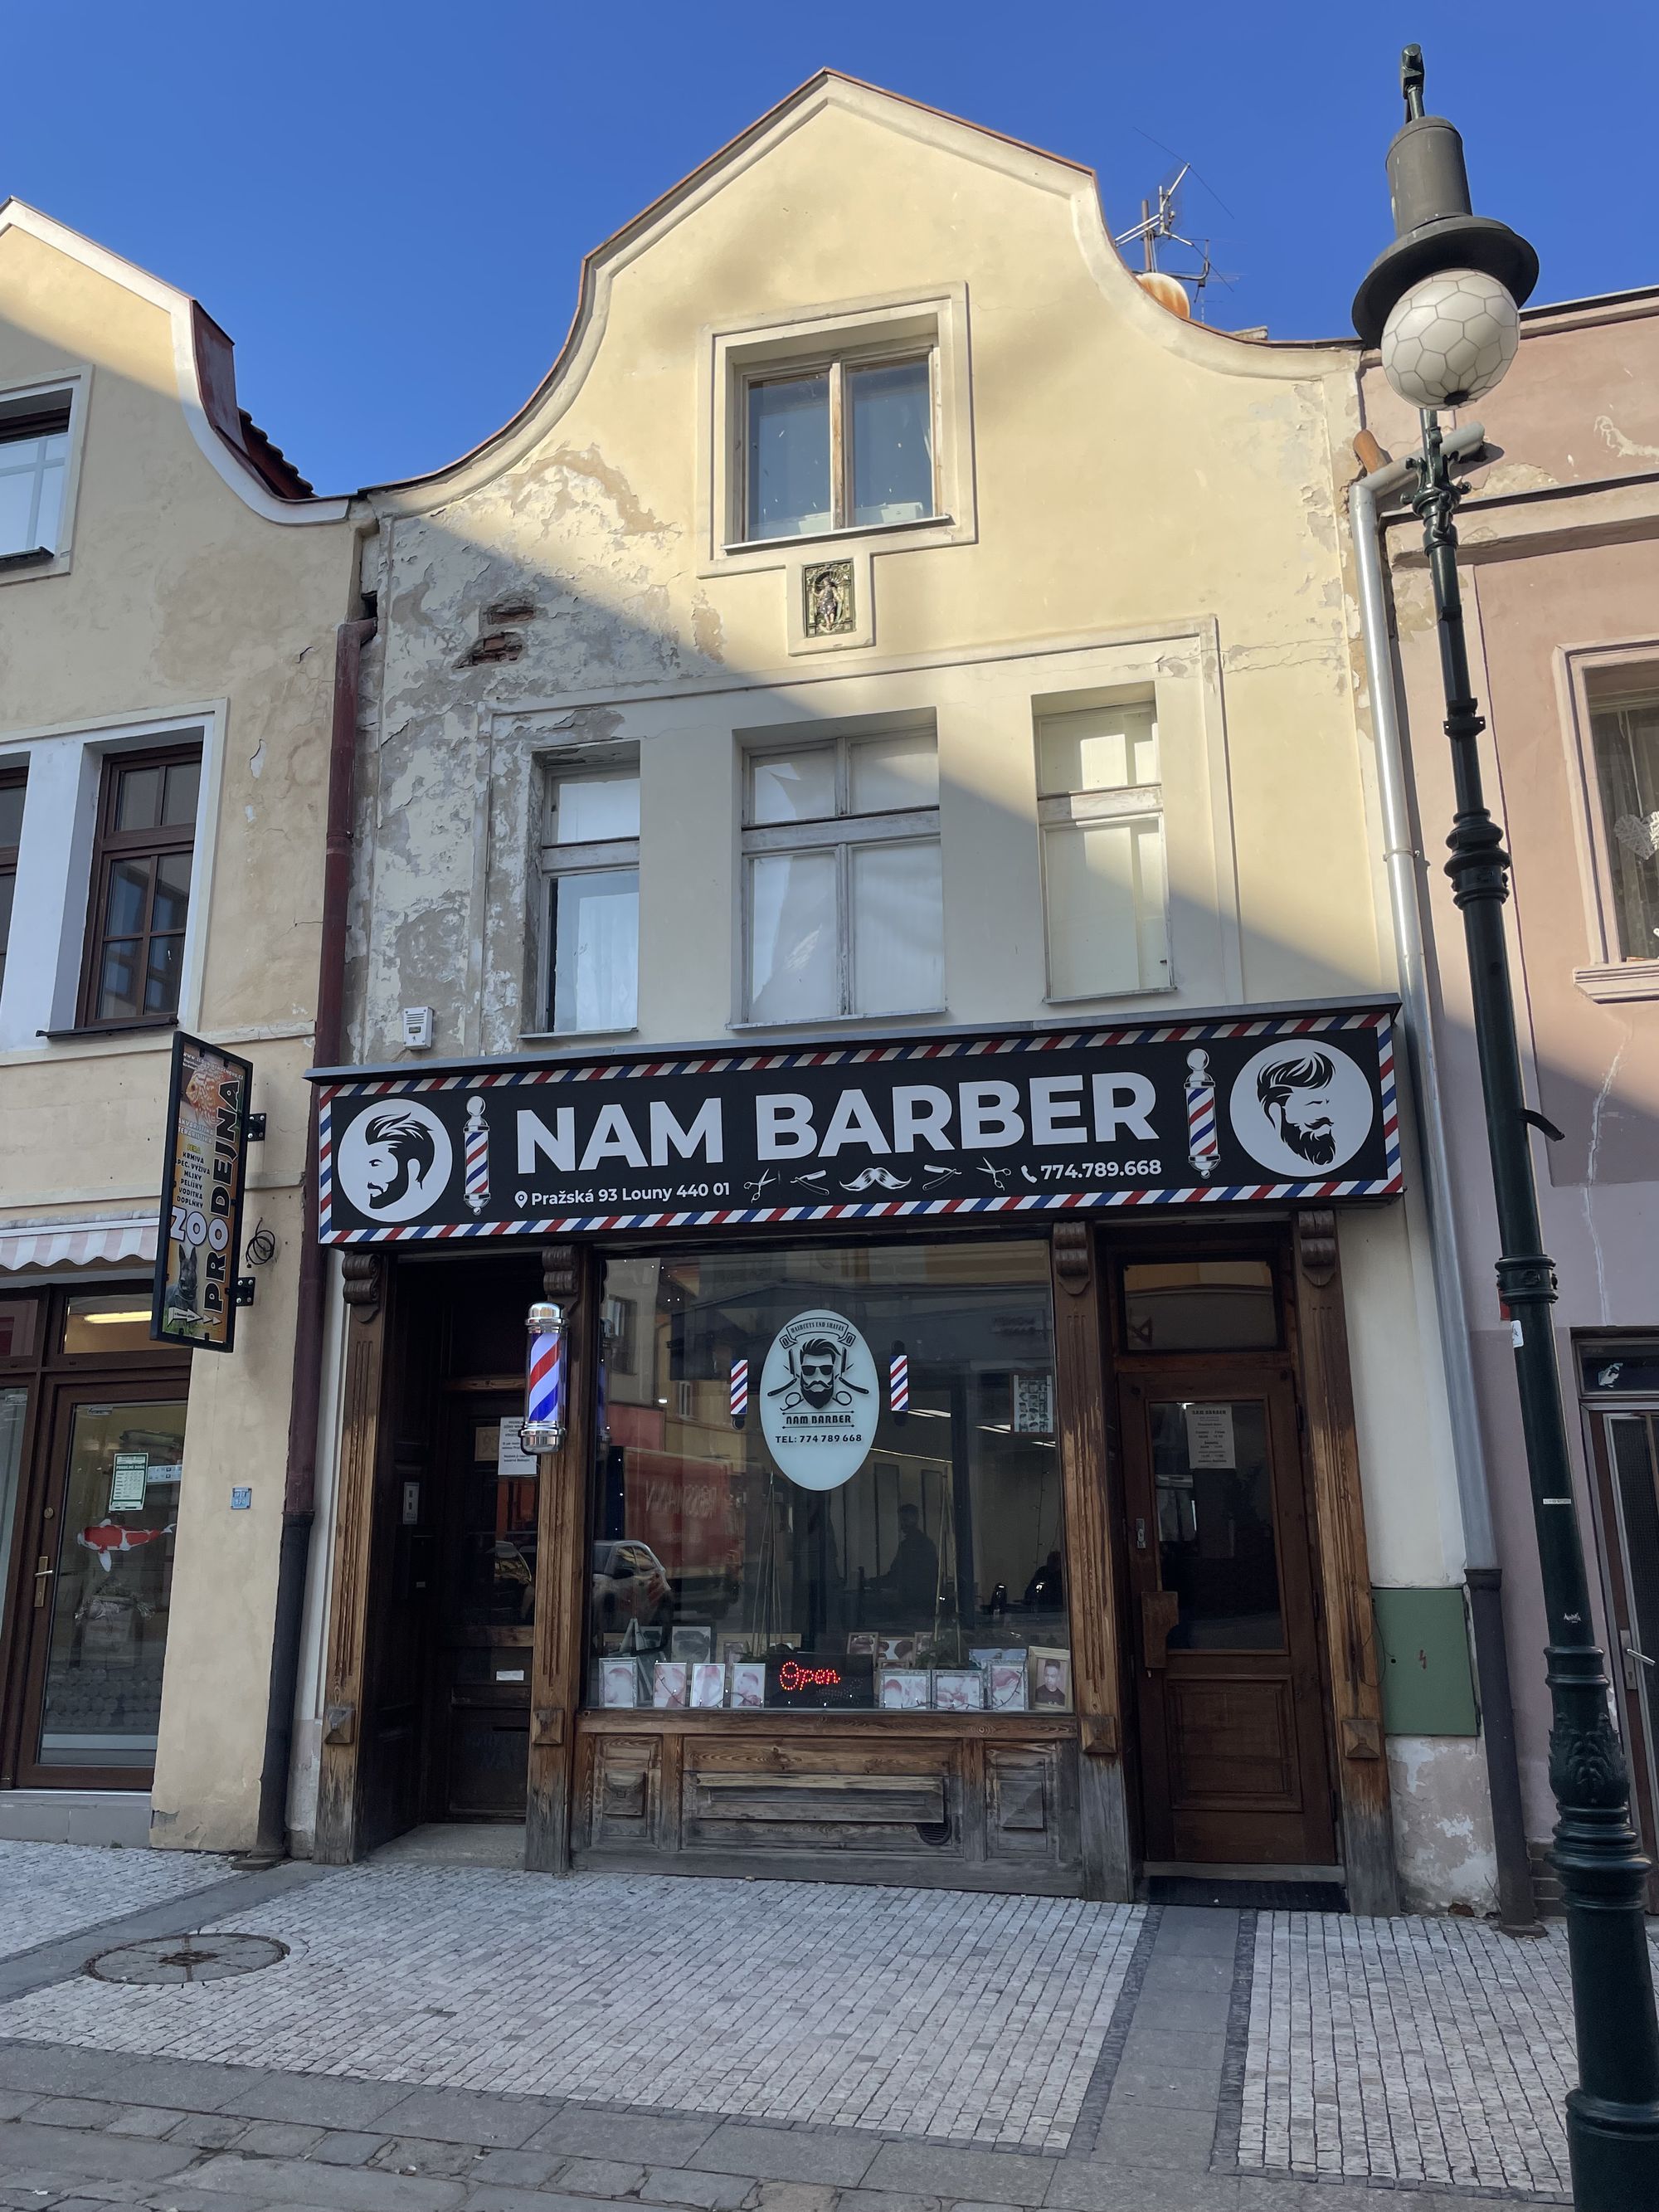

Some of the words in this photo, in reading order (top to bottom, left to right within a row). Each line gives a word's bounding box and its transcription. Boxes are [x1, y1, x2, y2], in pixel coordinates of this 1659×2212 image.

[516, 1097, 724, 1174] NAM
[755, 1071, 1160, 1161] BARBER
[182, 1152, 204, 1164] KRMIVA
[1040, 1159, 1162, 1180] 774.789.668
[203, 1079, 240, 1313] PRODEJNA
[531, 1187, 595, 1206] Pražská
[598, 1189, 618, 1203] 93
[622, 1186, 673, 1205] Louny
[676, 1184, 709, 1198] 440
[713, 1182, 730, 1196] 01
[169, 1205, 229, 1251] ZOO
[786, 1415, 809, 1424] NAM
[811, 1415, 851, 1424] BARBER
[800, 1435, 819, 1443] 774
[821, 1435, 839, 1443] 789
[843, 1434, 862, 1442] 668
[780, 1661, 841, 1691] Open
